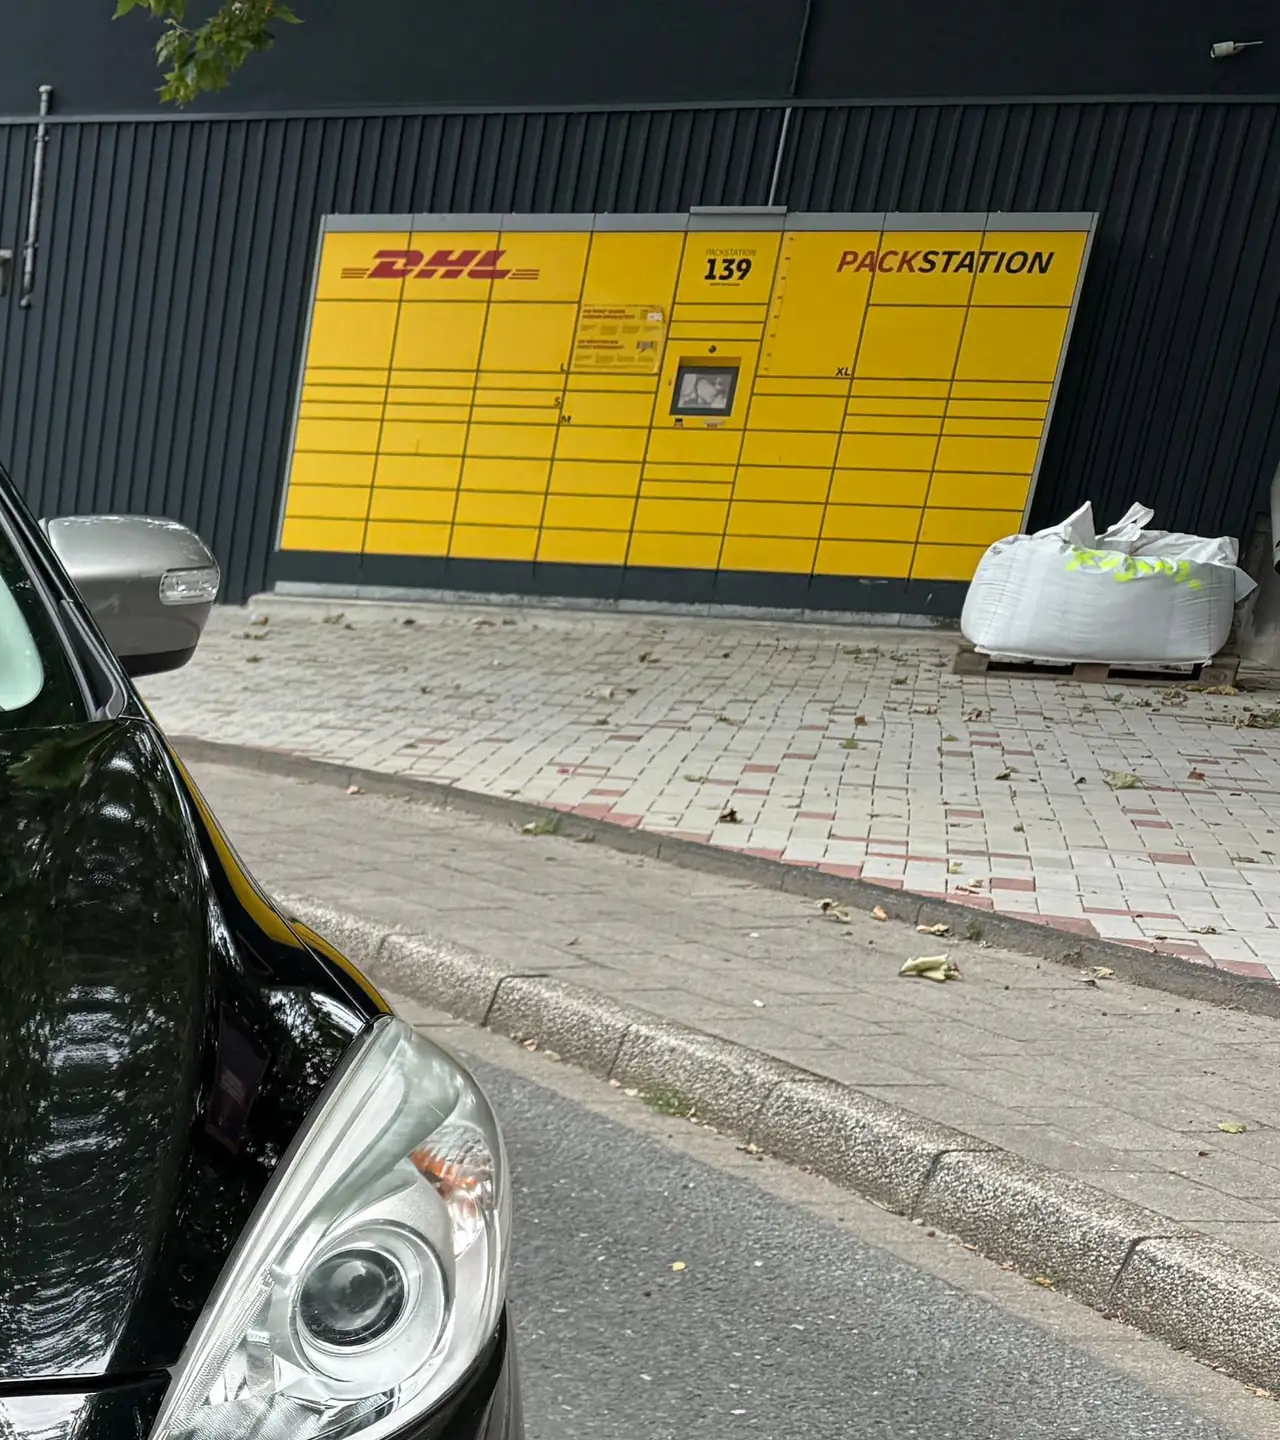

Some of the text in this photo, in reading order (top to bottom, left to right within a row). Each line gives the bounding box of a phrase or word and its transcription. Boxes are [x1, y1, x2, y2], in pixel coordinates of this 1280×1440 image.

[366, 249, 507, 280] DHL
[704, 258, 752, 280] 139
[836, 250, 1055, 274] PACKSTATION
[835, 367, 851, 376] XL
[561, 415, 571, 424] M
